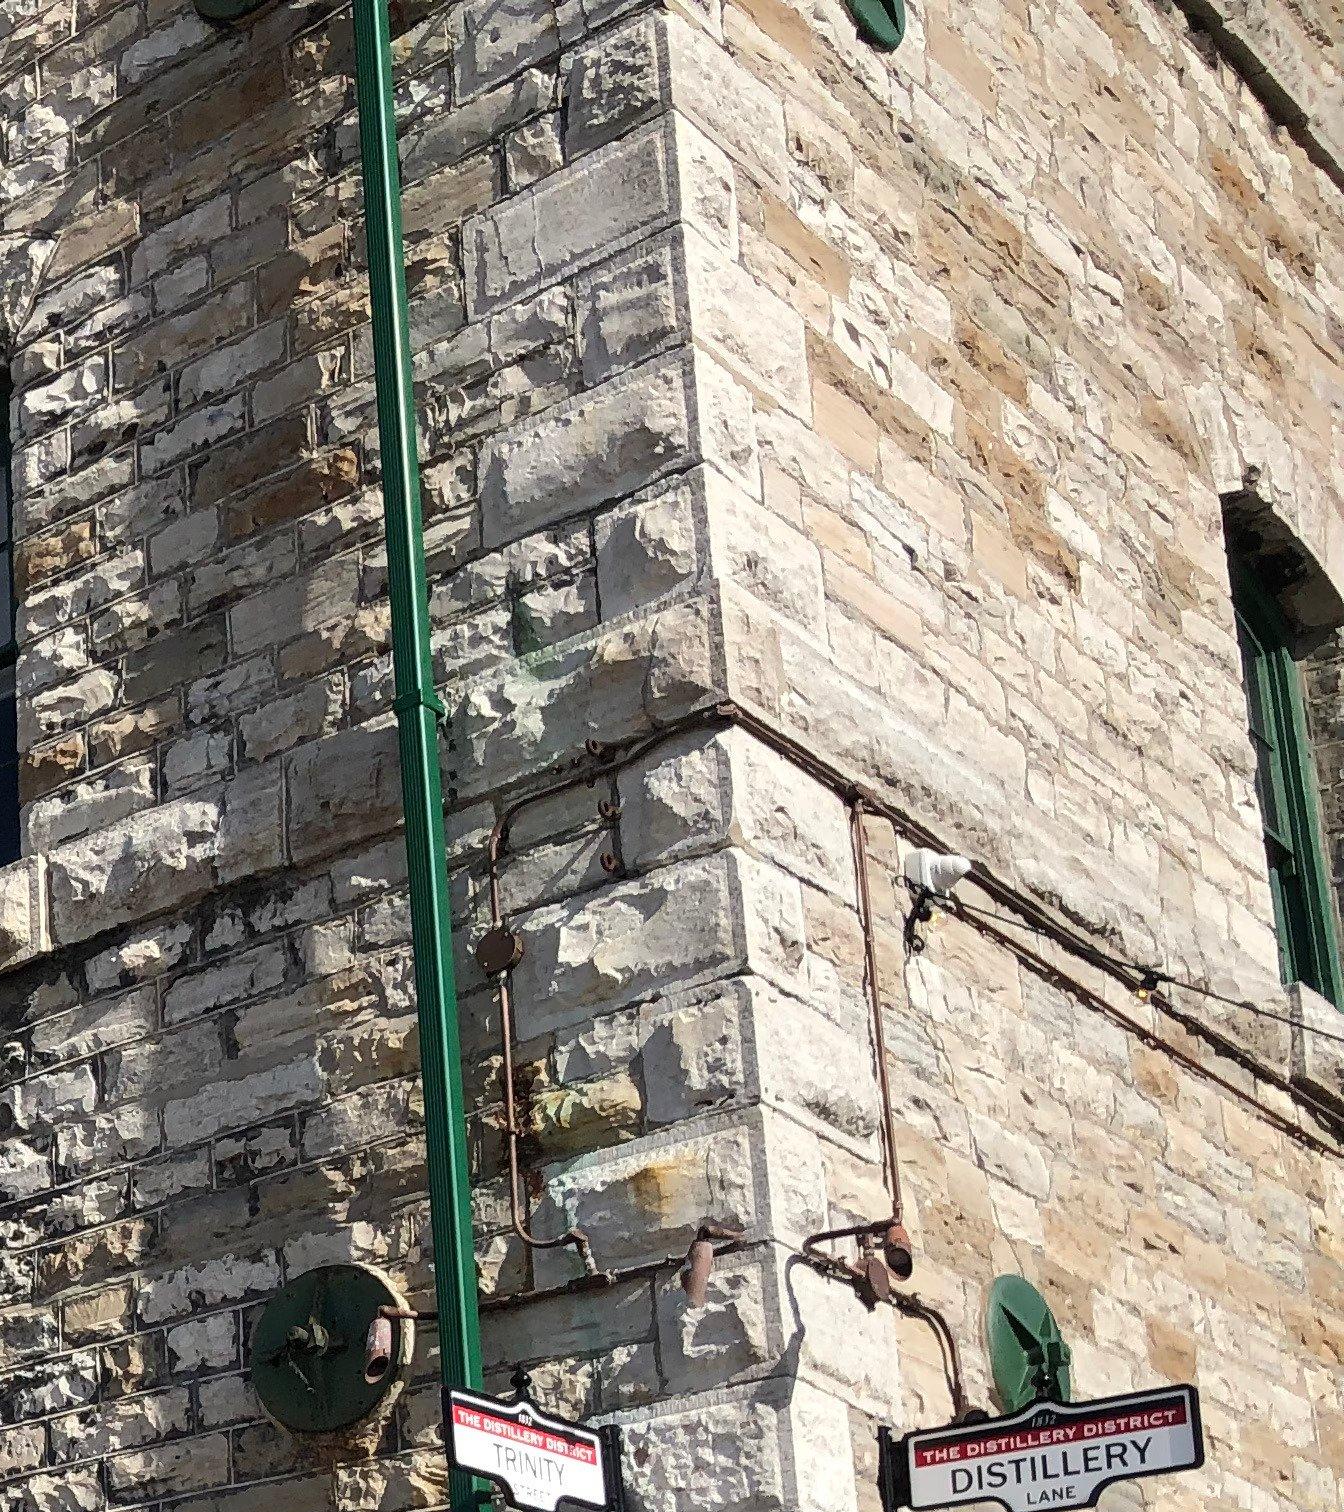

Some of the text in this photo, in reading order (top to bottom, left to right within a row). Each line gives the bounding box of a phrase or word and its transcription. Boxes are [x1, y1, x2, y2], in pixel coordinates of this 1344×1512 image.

[457, 1410, 481, 1428] THE
[483, 1418, 543, 1447] DISTILLERY
[922, 1410, 1177, 1464] THE DISTILLERY DISTRICT
[493, 1442, 565, 1486] TRINITY
[951, 1437, 1153, 1495] DISTILLERY
[1026, 1486, 1077, 1505] LANE
